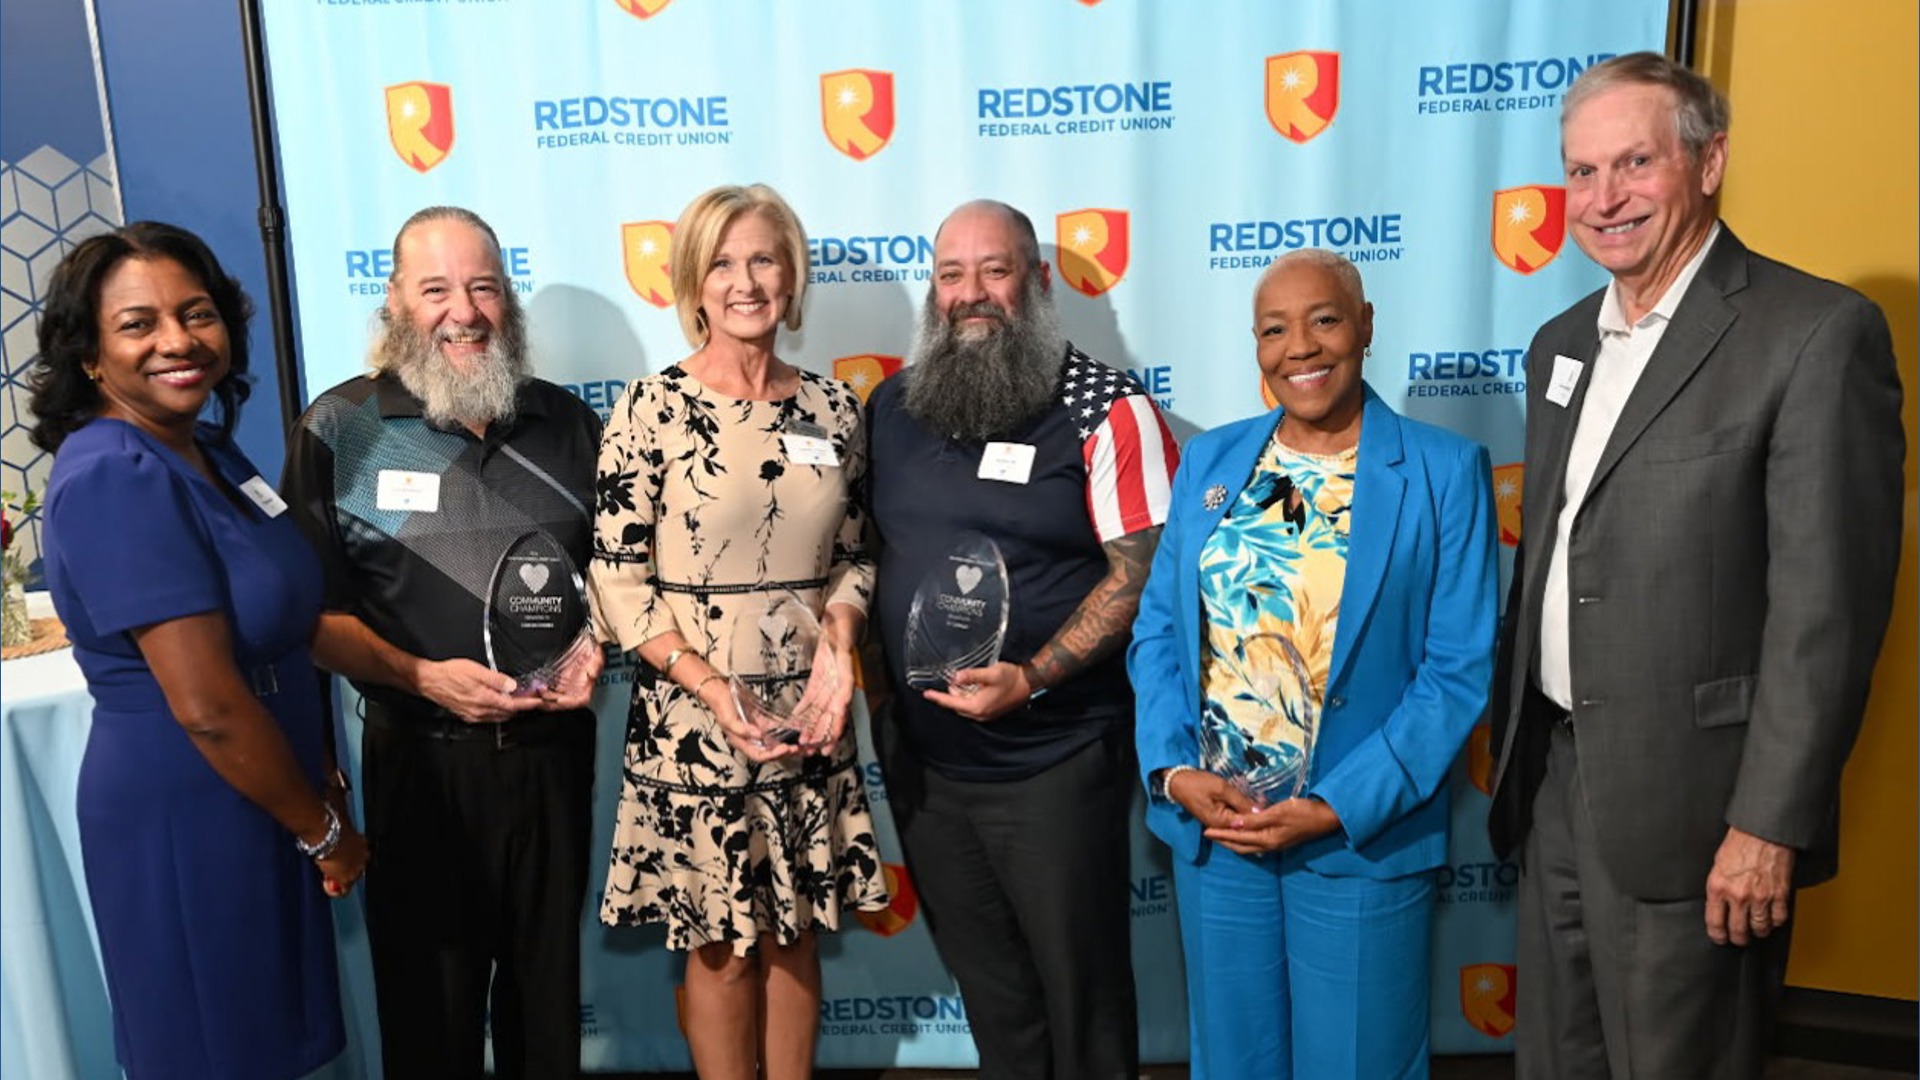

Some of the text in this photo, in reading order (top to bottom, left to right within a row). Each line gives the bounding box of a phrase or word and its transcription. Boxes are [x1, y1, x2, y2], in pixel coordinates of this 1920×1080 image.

[1419, 53, 1616, 96] REDSTON
[978, 82, 1172, 118] REDSTONE
[1419, 98, 1491, 114] FEDERAL
[1495, 95, 1556, 111] CREDIT
[534, 96, 728, 130] REDSTONE
[979, 123, 1051, 137] FEDERAL
[1056, 119, 1115, 134] CREDIT
[537, 131, 610, 148] FEDERAL
[614, 132, 673, 146] CREDIT
[1210, 214, 1401, 252] REDSTONE
[808, 235, 935, 266] EDSTON
[1210, 255, 1277, 270] FEDERA
[808, 270, 846, 284] ERAL
[851, 269, 909, 282] CREDIT
[1409, 349, 1529, 380] REDST
[1407, 381, 1526, 397] FEDERAL CRED
[1436, 862, 1518, 889] DSTO
[1131, 902, 1169, 918] NION
[820, 996, 962, 1022] REDSTON
[822, 1023, 973, 1036] EDERAL CREDIT UNIO
